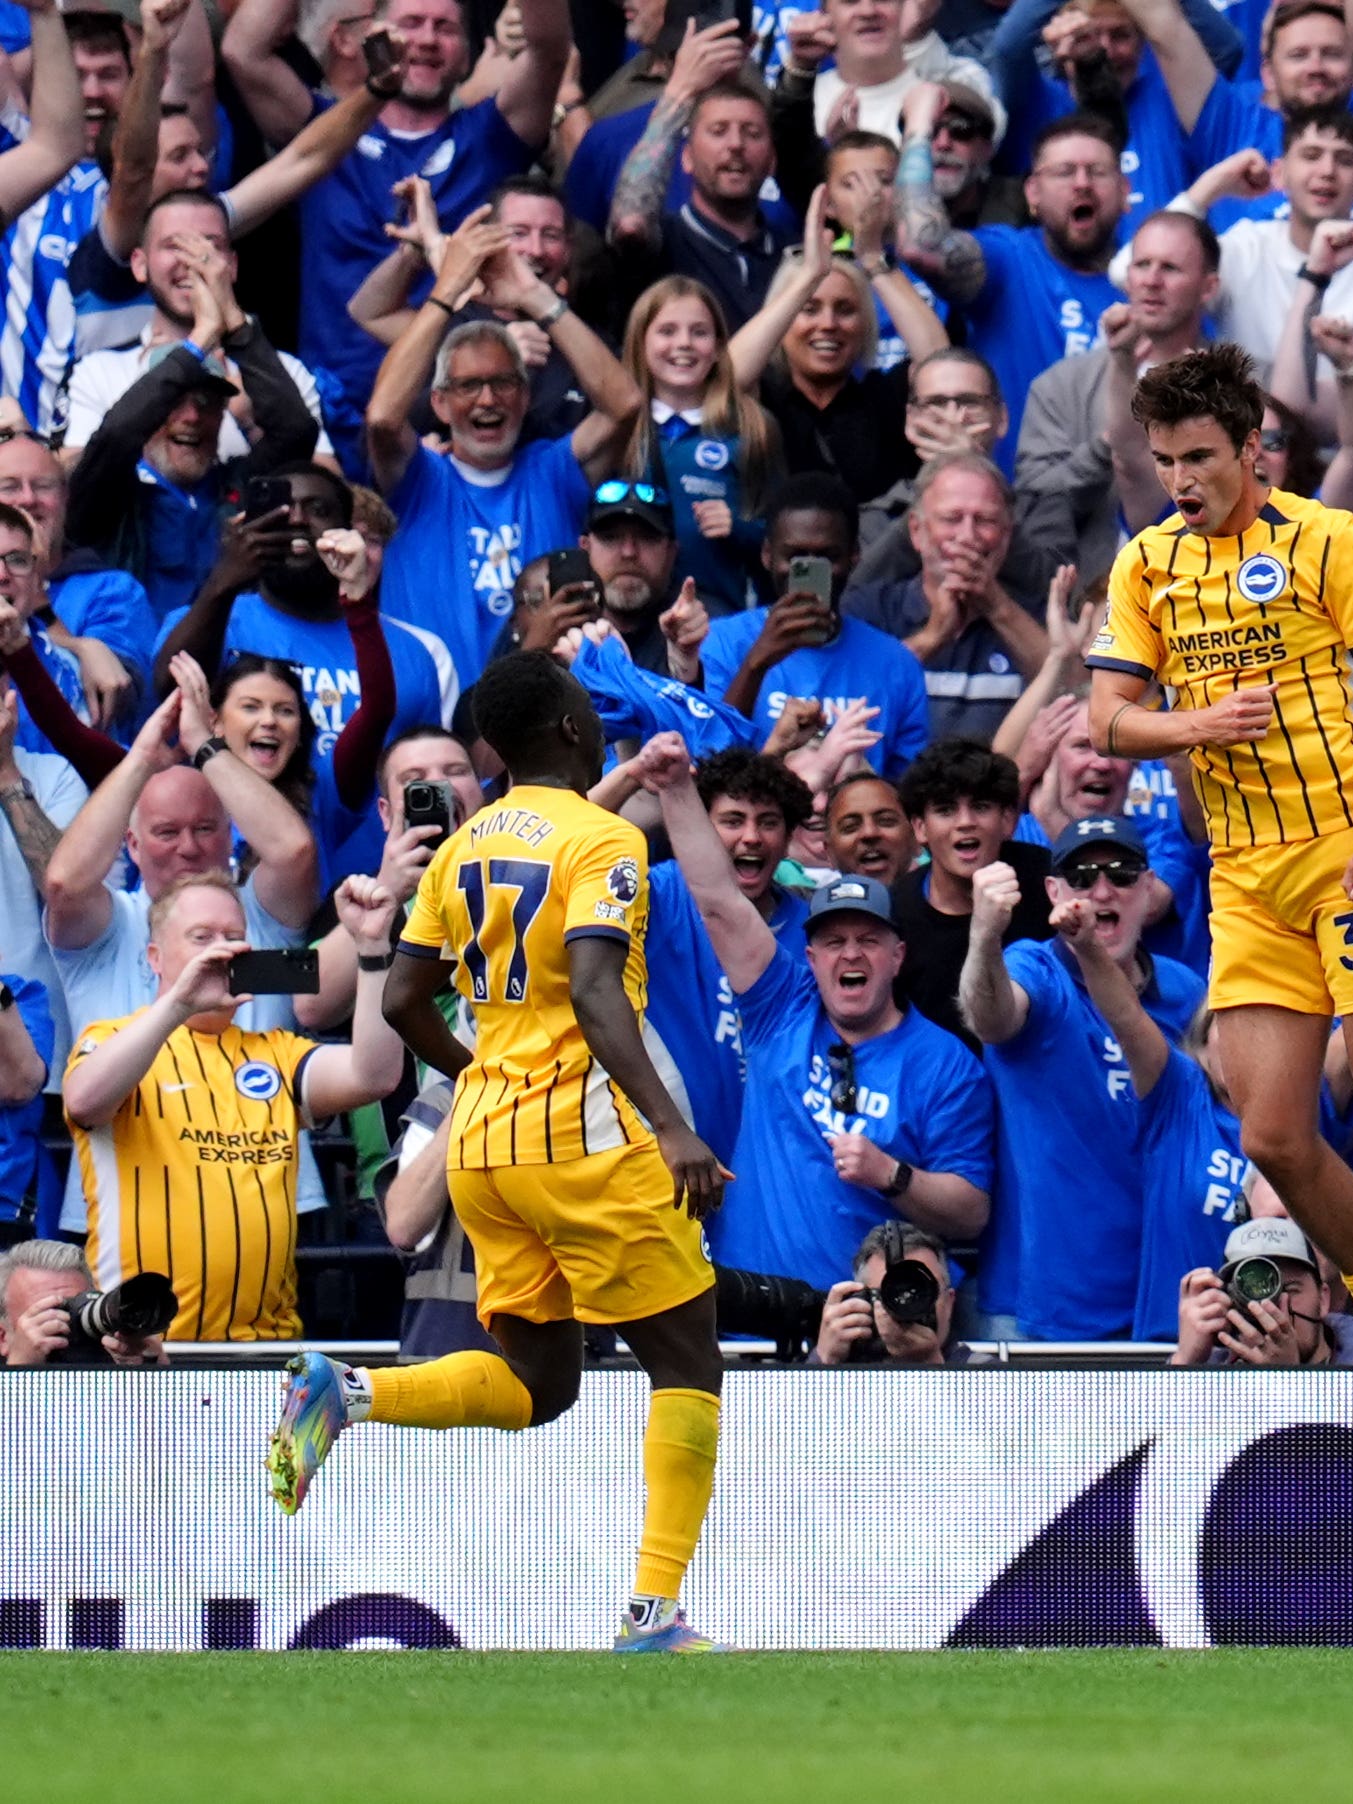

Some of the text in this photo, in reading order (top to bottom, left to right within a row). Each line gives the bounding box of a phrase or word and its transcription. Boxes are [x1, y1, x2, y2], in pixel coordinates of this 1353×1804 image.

[1168, 622, 1282, 655] AMERICAN
[1183, 642, 1288, 674] EXPRESS
[470, 809, 554, 850] MINTEH
[456, 857, 552, 1003] 17
[178, 1127, 290, 1147] AMERICAN
[198, 1145, 294, 1165] EXPRESS
